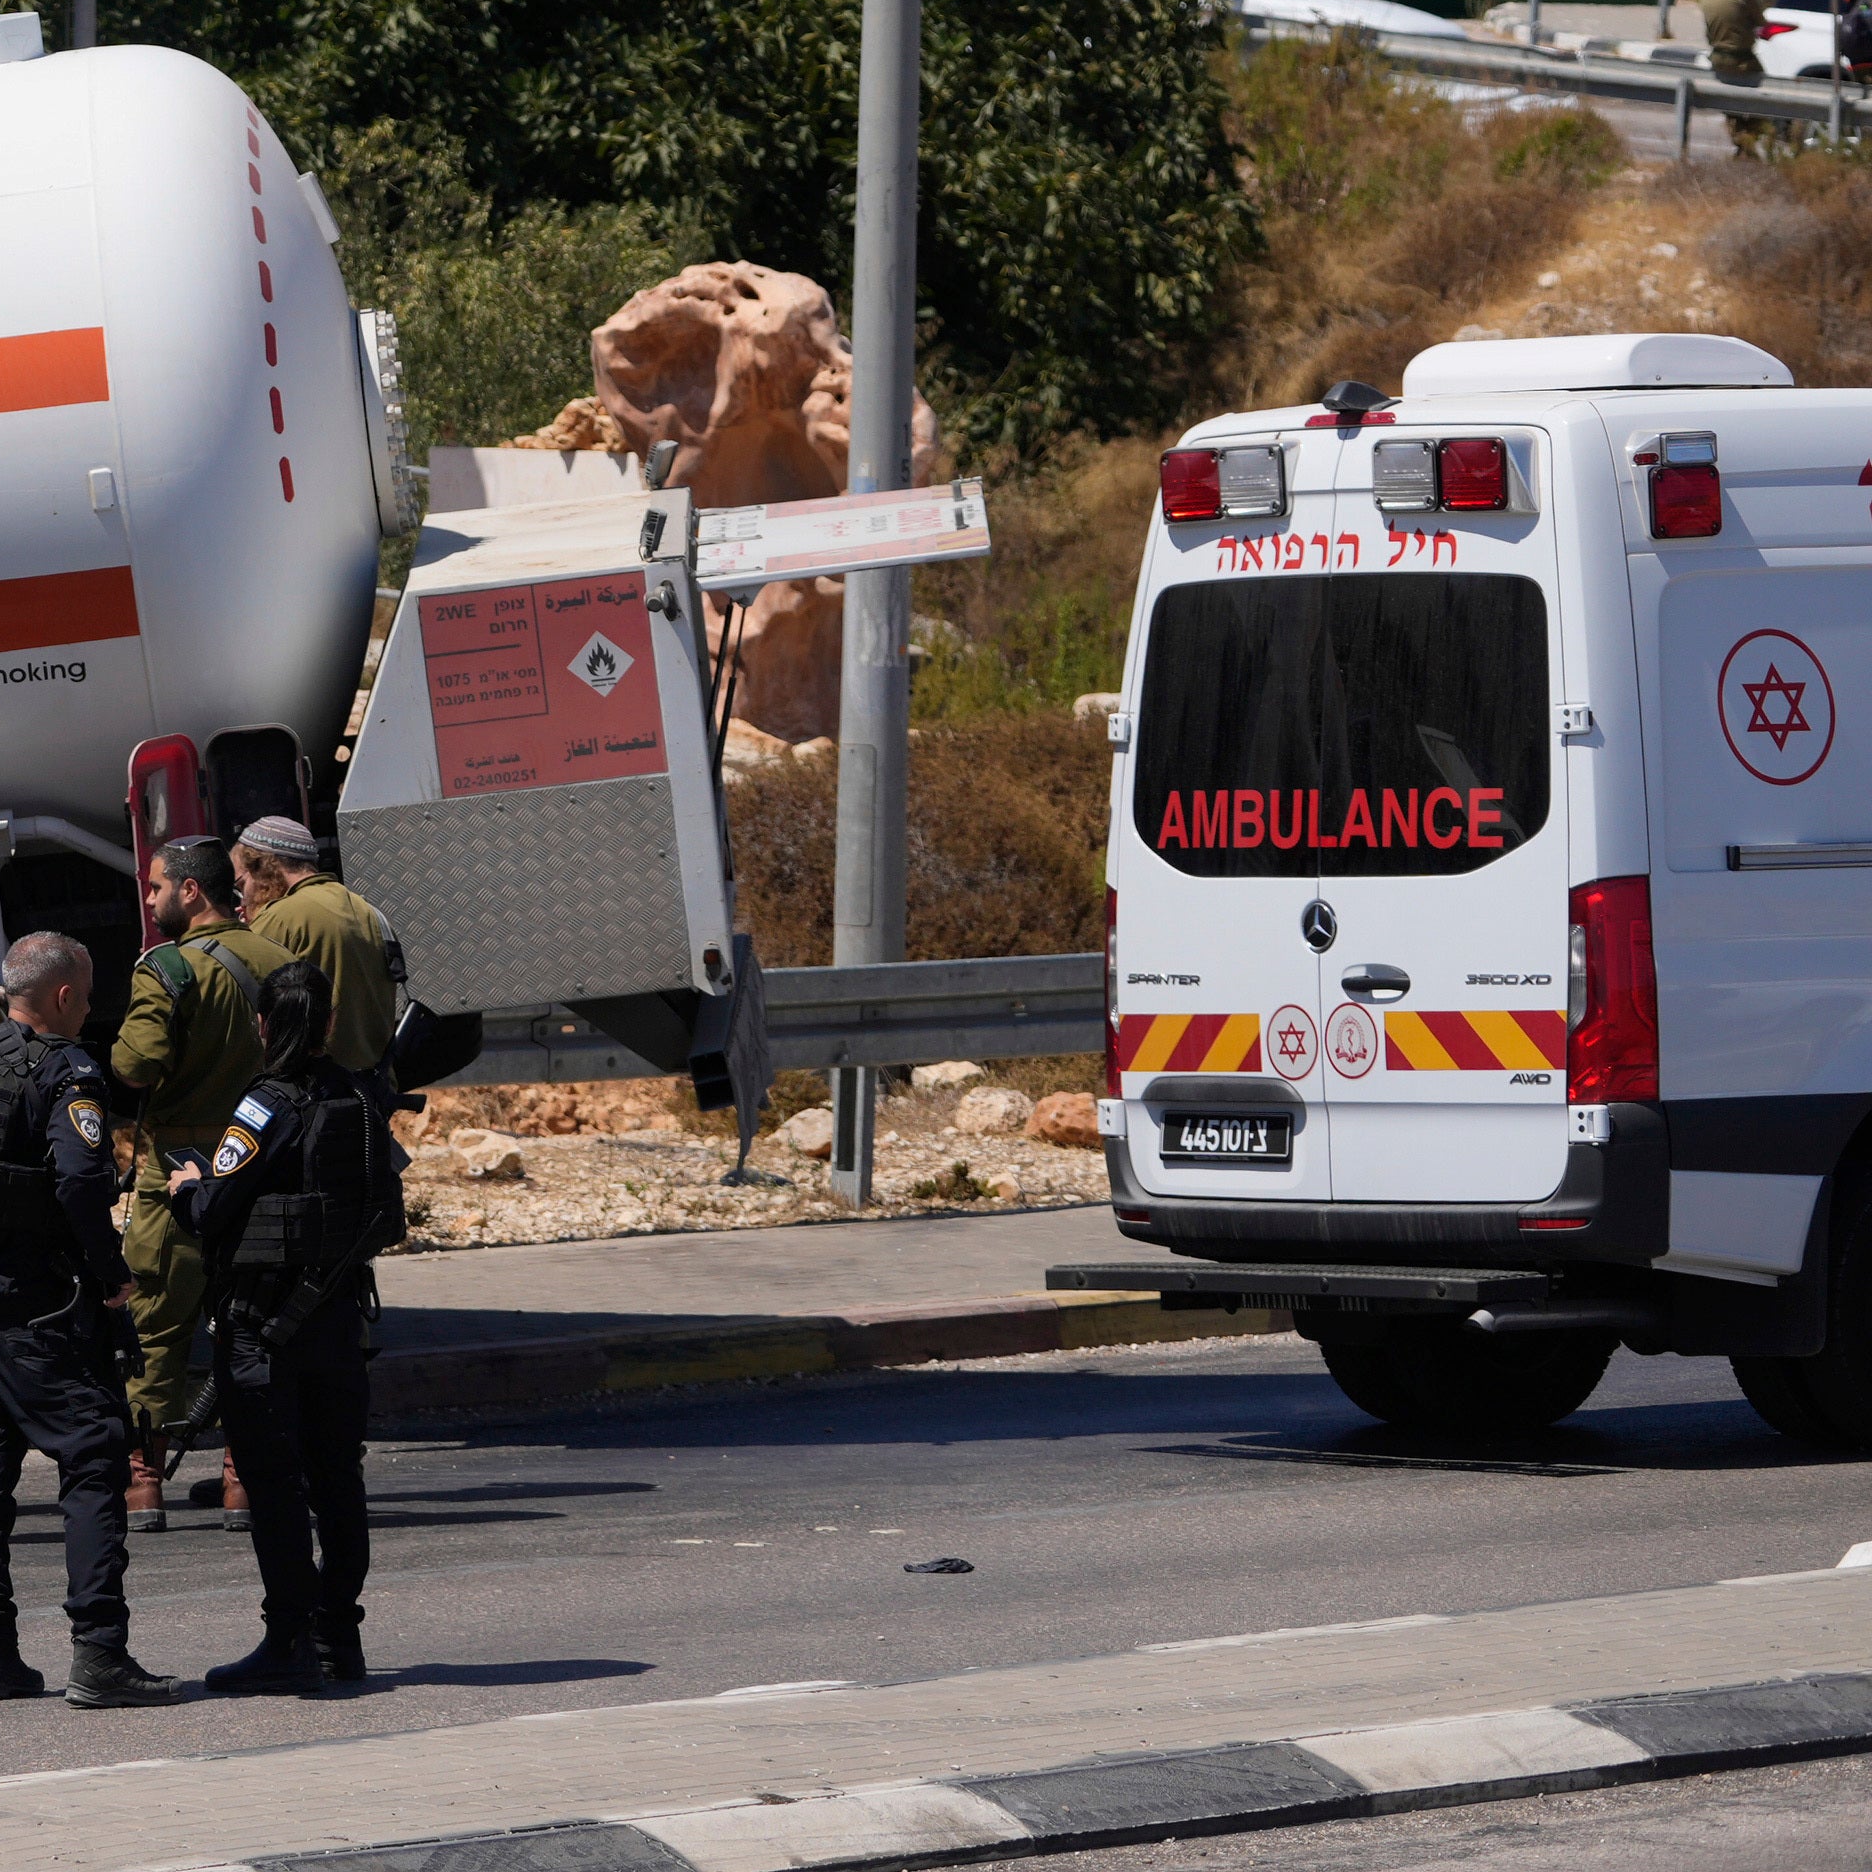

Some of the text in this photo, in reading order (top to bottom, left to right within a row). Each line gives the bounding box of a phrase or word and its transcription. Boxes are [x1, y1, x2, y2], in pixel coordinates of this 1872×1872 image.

[1216, 519, 1458, 573] חיל הרפואה
[436, 599, 526, 621] צופן 2WE
[489, 619, 528, 634] חרום
[437, 673, 471, 688] 1075
[454, 768, 537, 789] 02-2400251
[1157, 787, 1505, 850] AMBULANCE
[1126, 972, 1202, 987] SPRINTER
[1509, 1072, 1552, 1086] AWD
